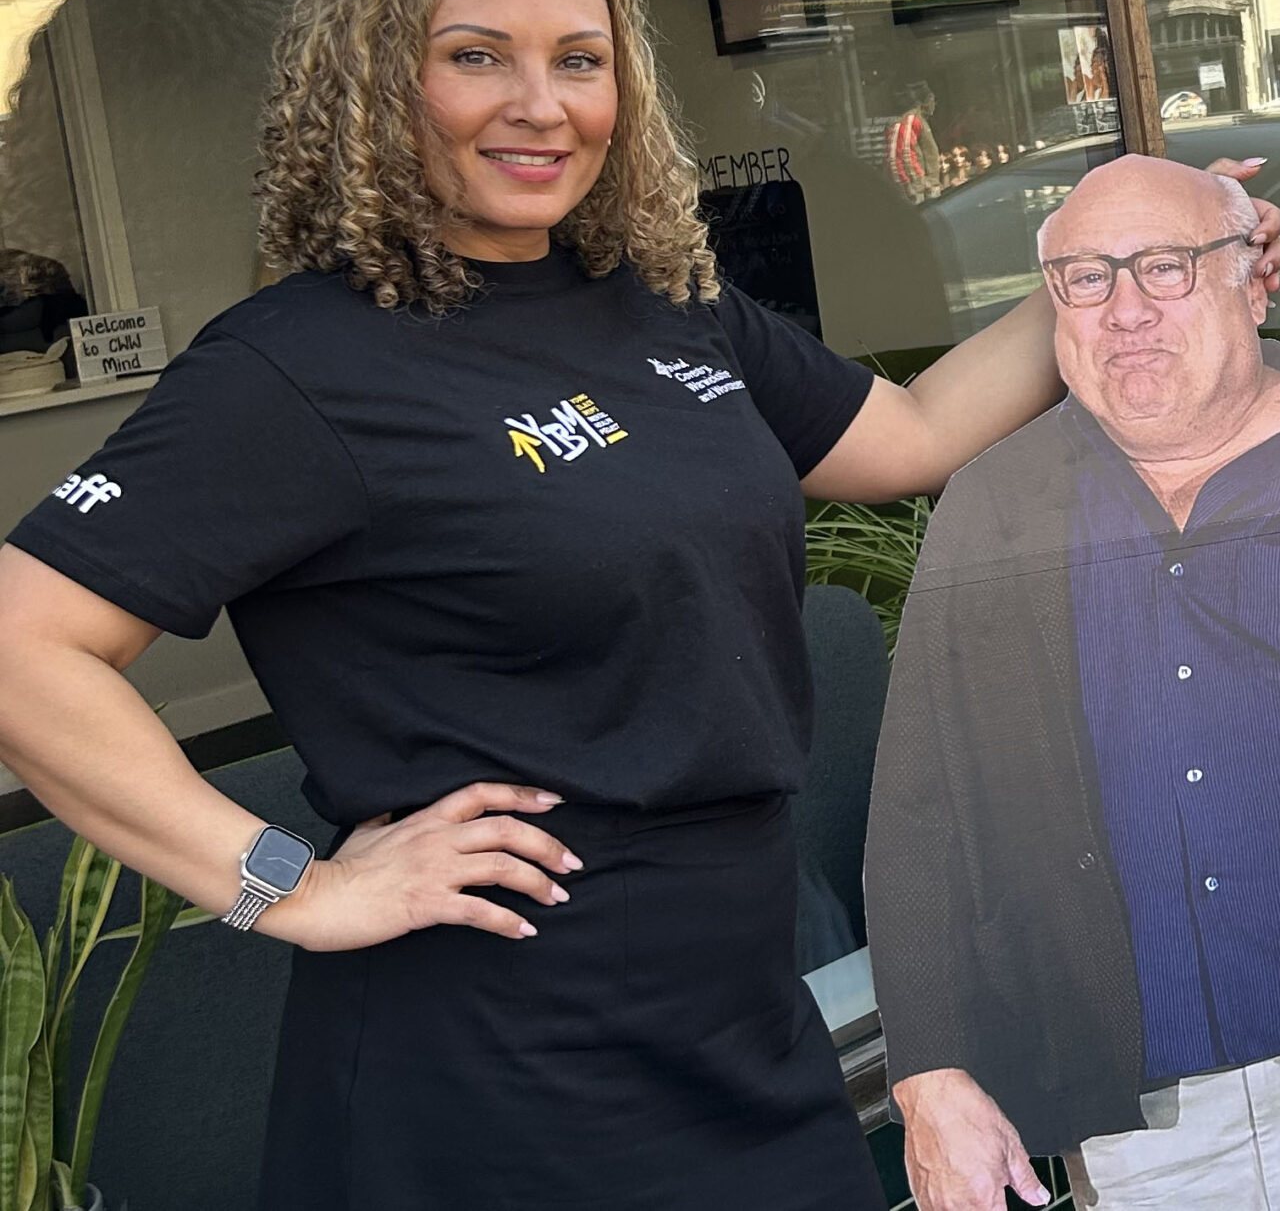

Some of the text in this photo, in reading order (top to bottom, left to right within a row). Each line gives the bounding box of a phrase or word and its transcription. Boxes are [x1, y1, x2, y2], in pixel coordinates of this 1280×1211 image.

[79, 316, 146, 337] Welcome
[82, 333, 141, 357] to CWW
[102, 354, 141, 374] Mind
[504, 400, 607, 461] YBM
